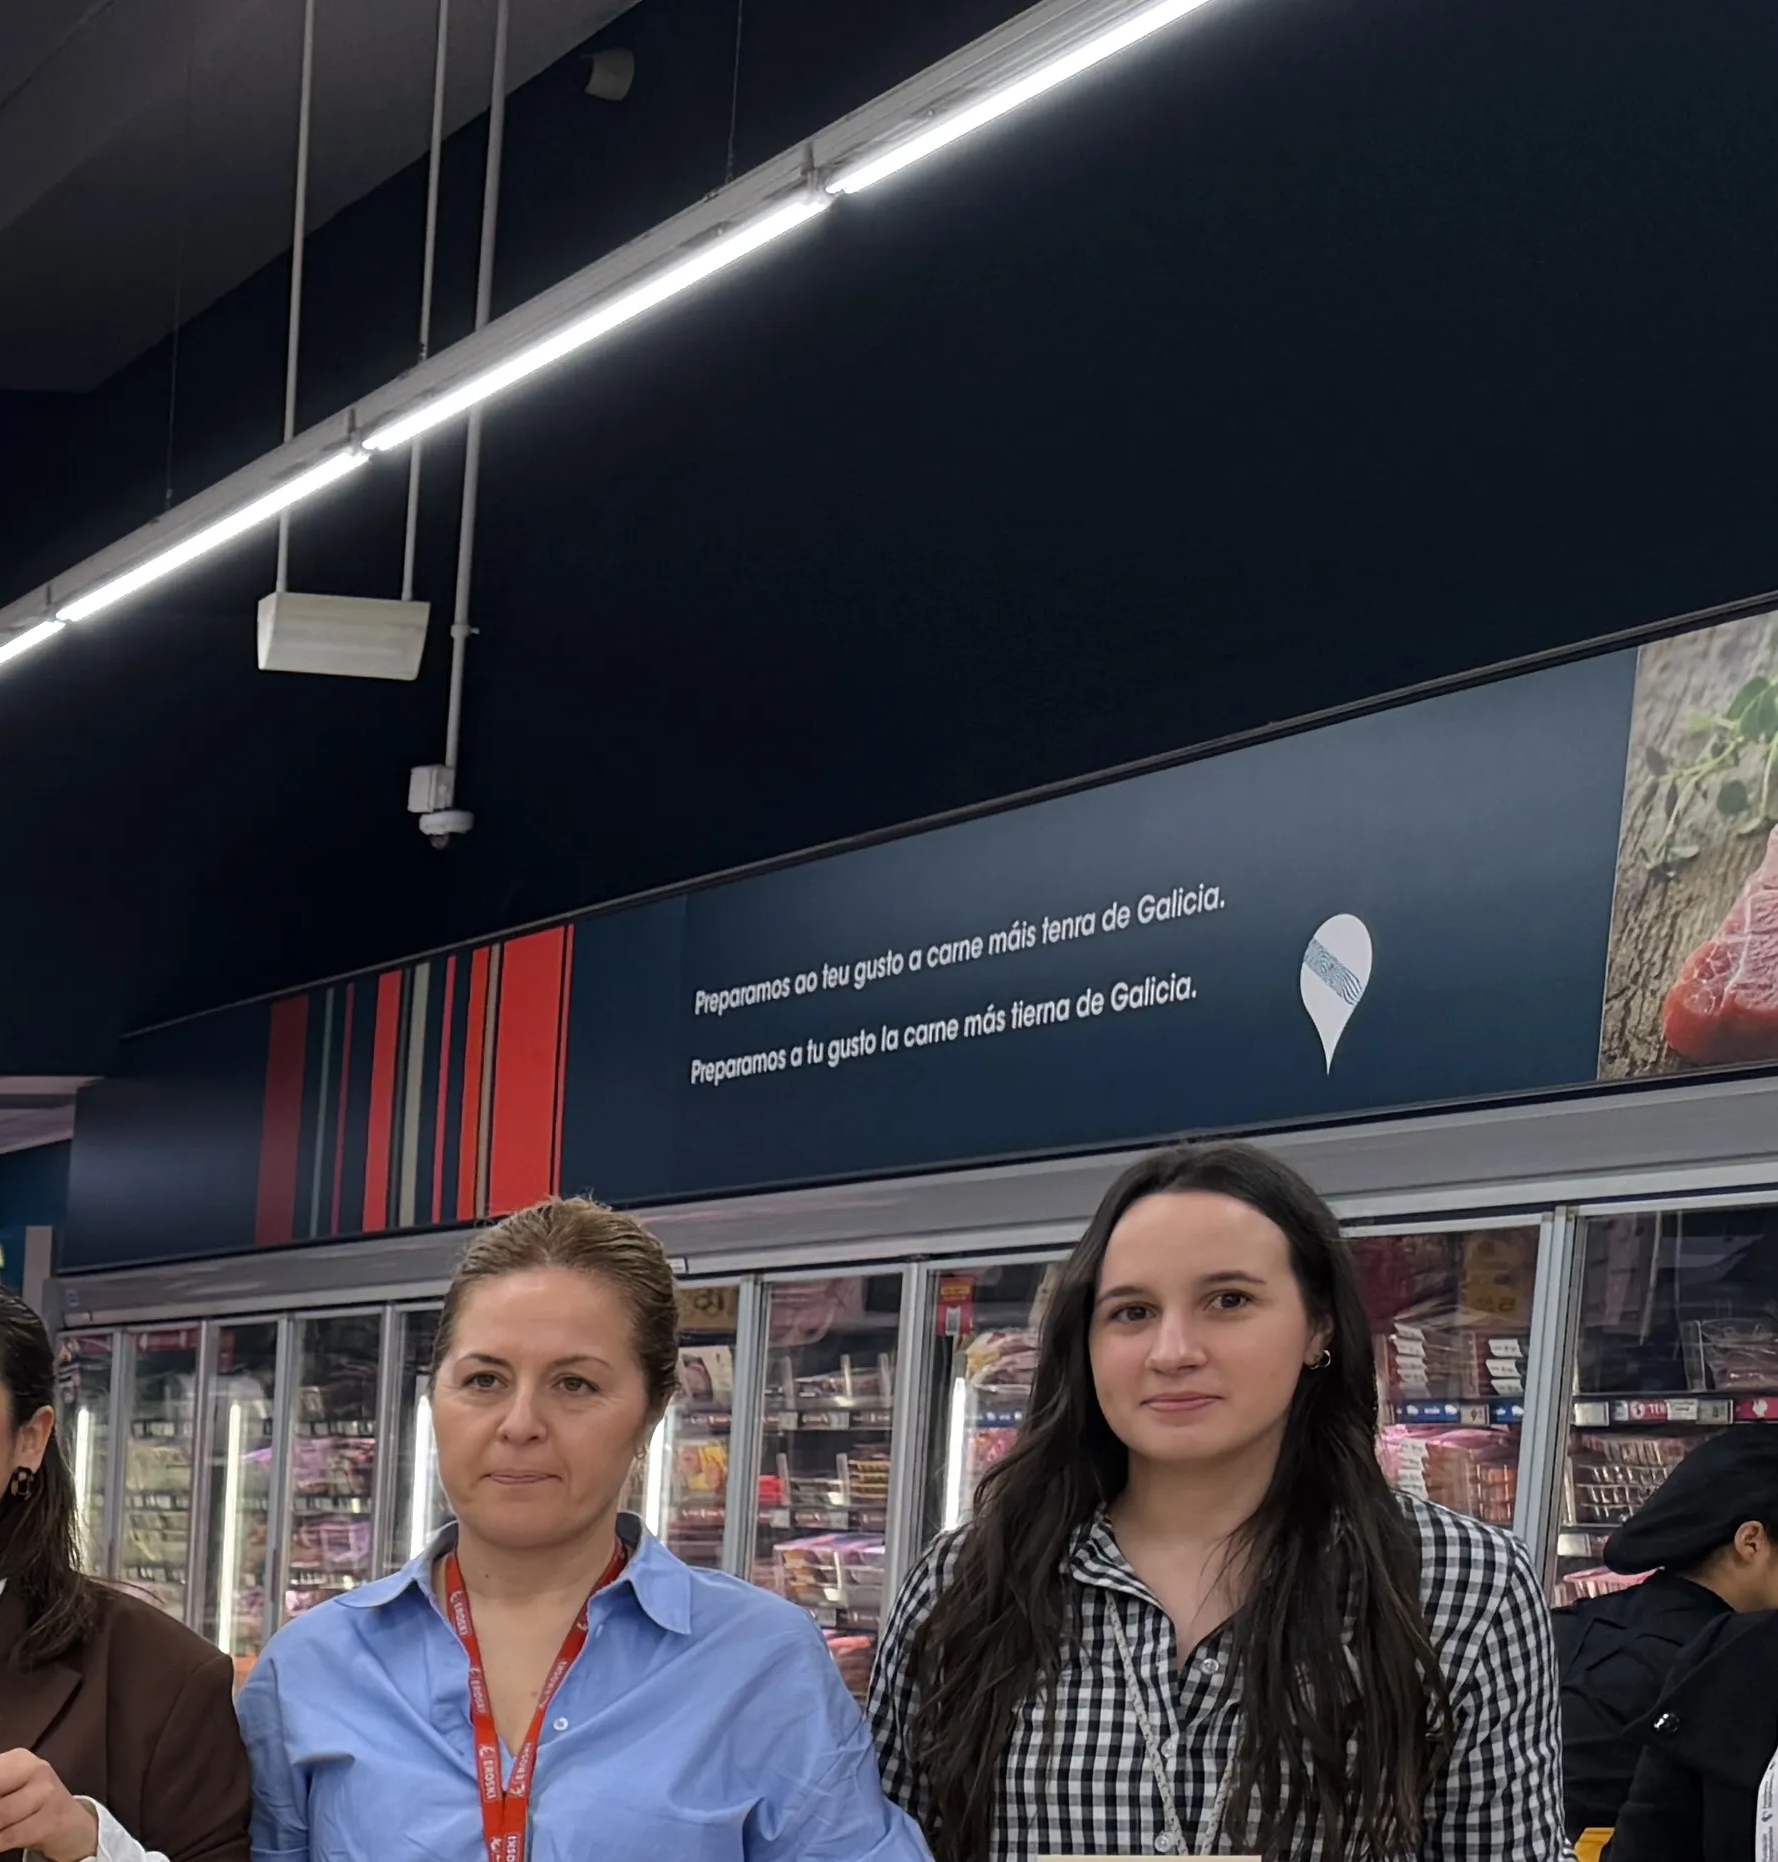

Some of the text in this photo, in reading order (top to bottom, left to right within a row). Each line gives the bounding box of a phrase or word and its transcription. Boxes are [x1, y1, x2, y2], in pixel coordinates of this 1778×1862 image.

[694, 883, 1225, 1016] Preparamos ao teu gusto a carne máis tenra de Galicia.
[691, 973, 1197, 1086] Preparamos a tu gusto la carne más tierna de Galicia.
